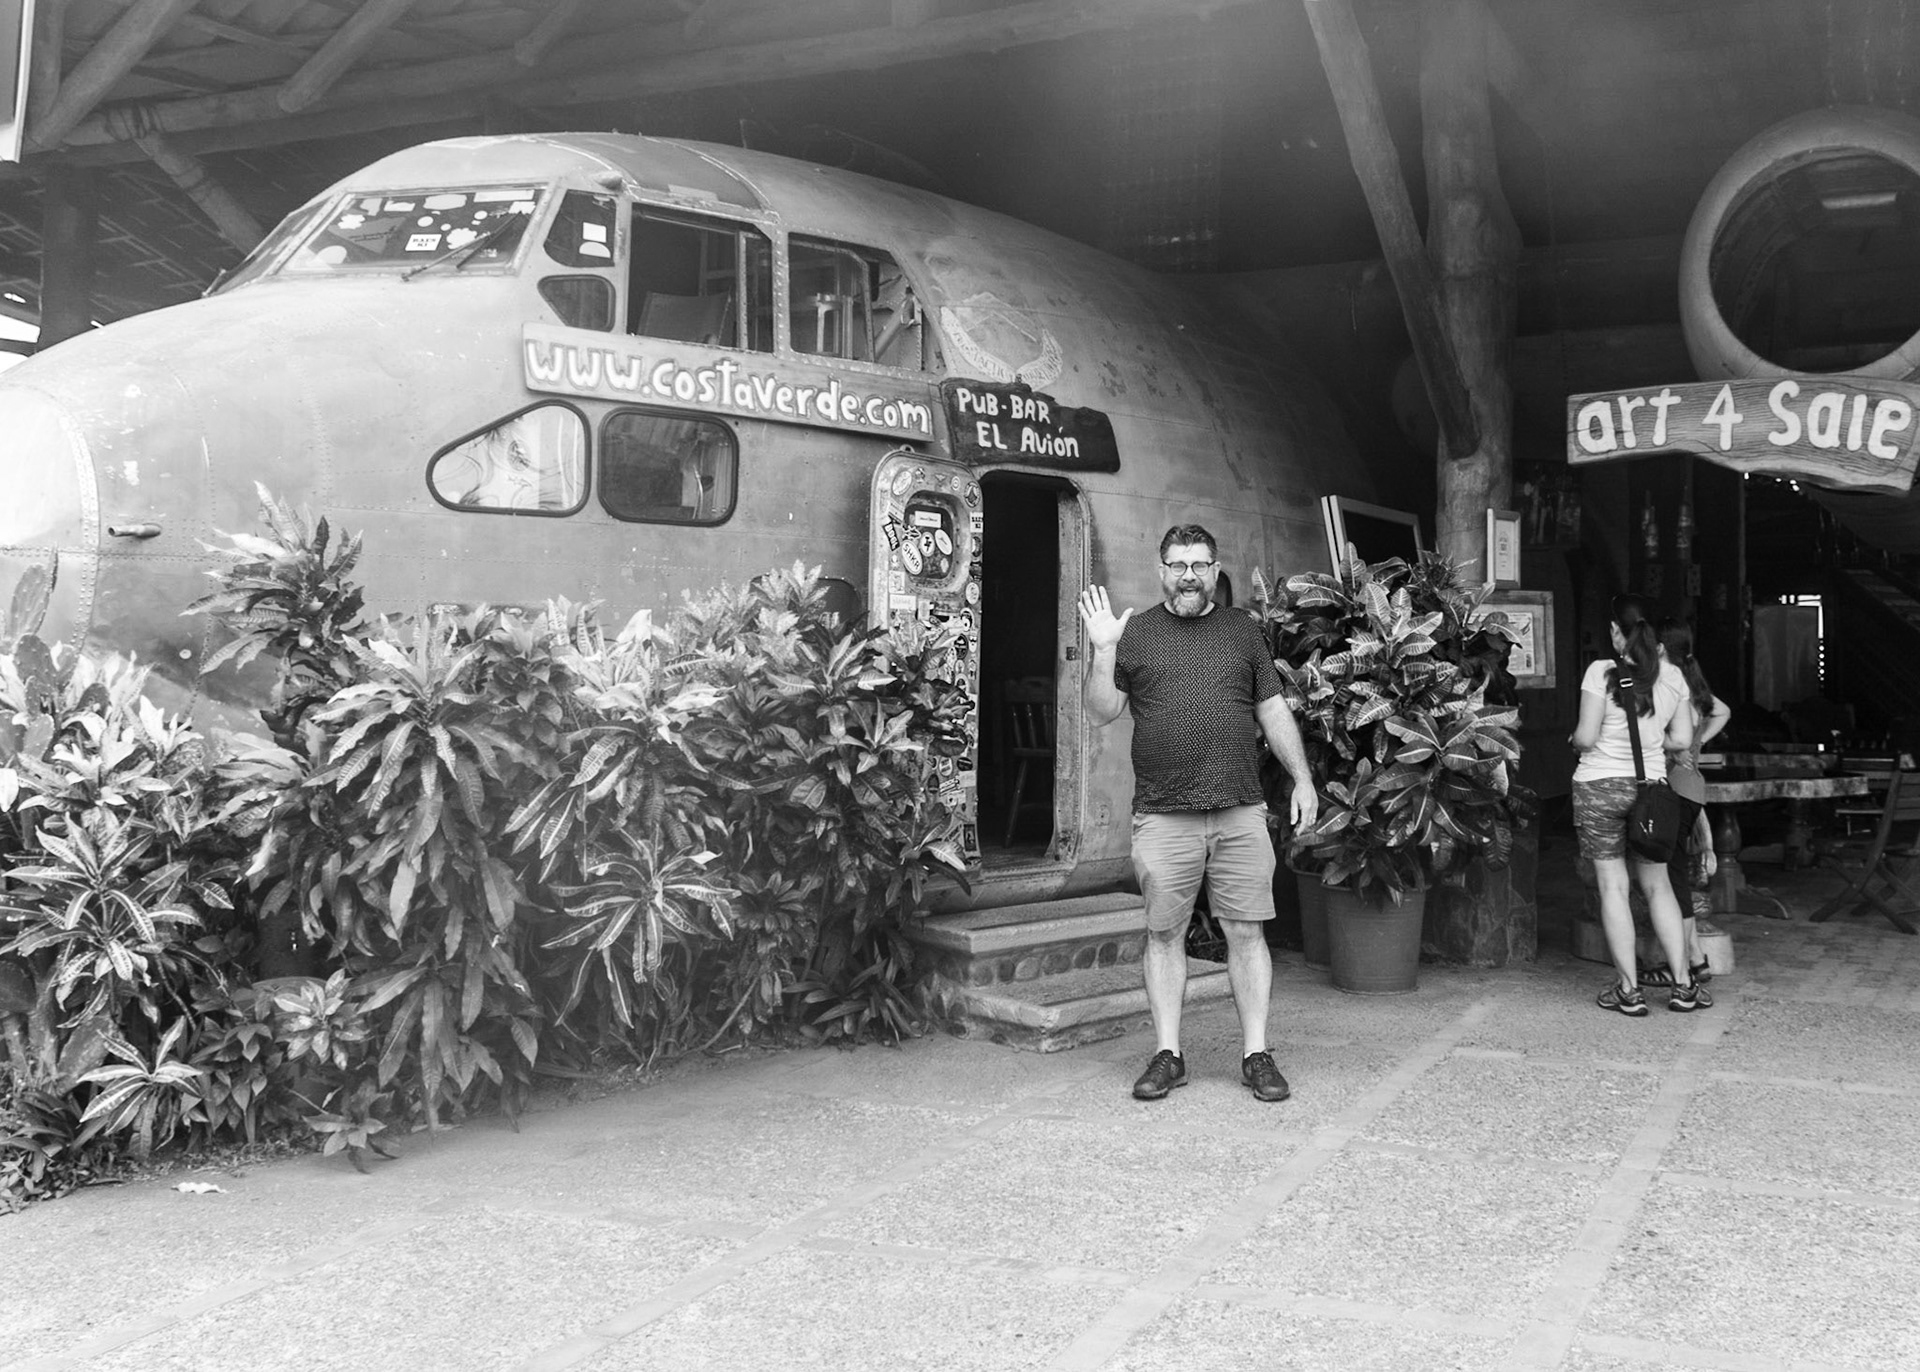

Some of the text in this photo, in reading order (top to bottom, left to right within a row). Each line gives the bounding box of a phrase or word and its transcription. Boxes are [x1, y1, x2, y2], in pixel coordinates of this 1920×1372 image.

[976, 421, 1007, 449] EL
[1577, 380, 1911, 459] art 4 Sale
